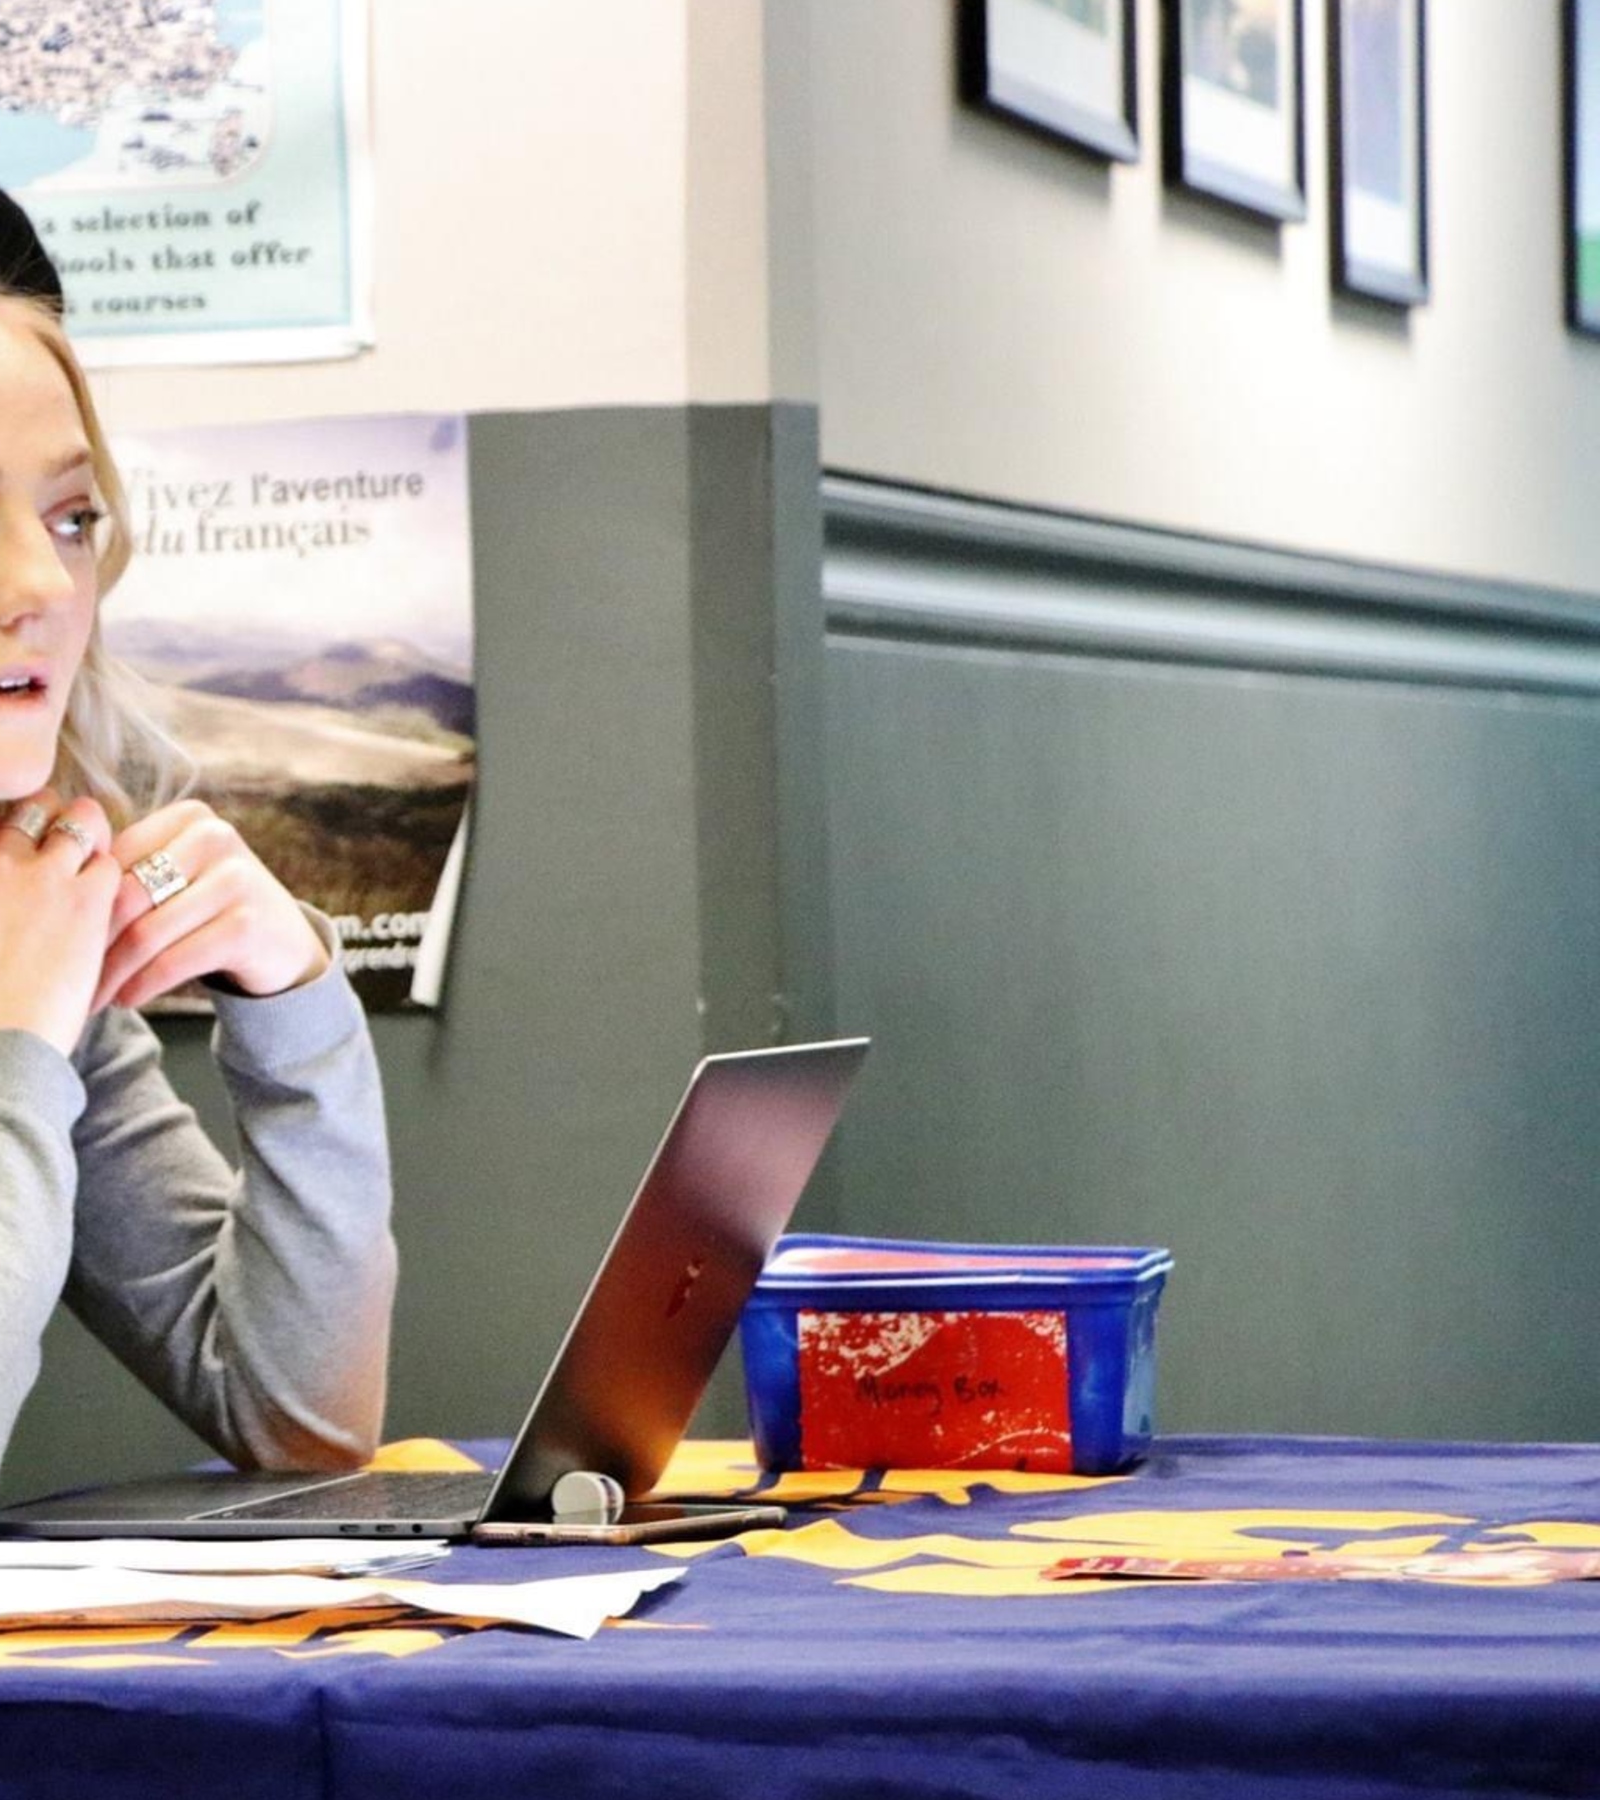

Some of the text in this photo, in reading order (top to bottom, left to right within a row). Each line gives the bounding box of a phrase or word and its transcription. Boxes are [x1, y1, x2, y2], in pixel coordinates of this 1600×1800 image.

[72, 203, 211, 231] selection
[227, 199, 260, 225] of
[51, 240, 311, 273] hools that offer
[92, 295, 206, 314] courses
[252, 471, 425, 505] l'aventure
[196, 504, 371, 557] français
[855, 1374, 1008, 1416] Money Box
